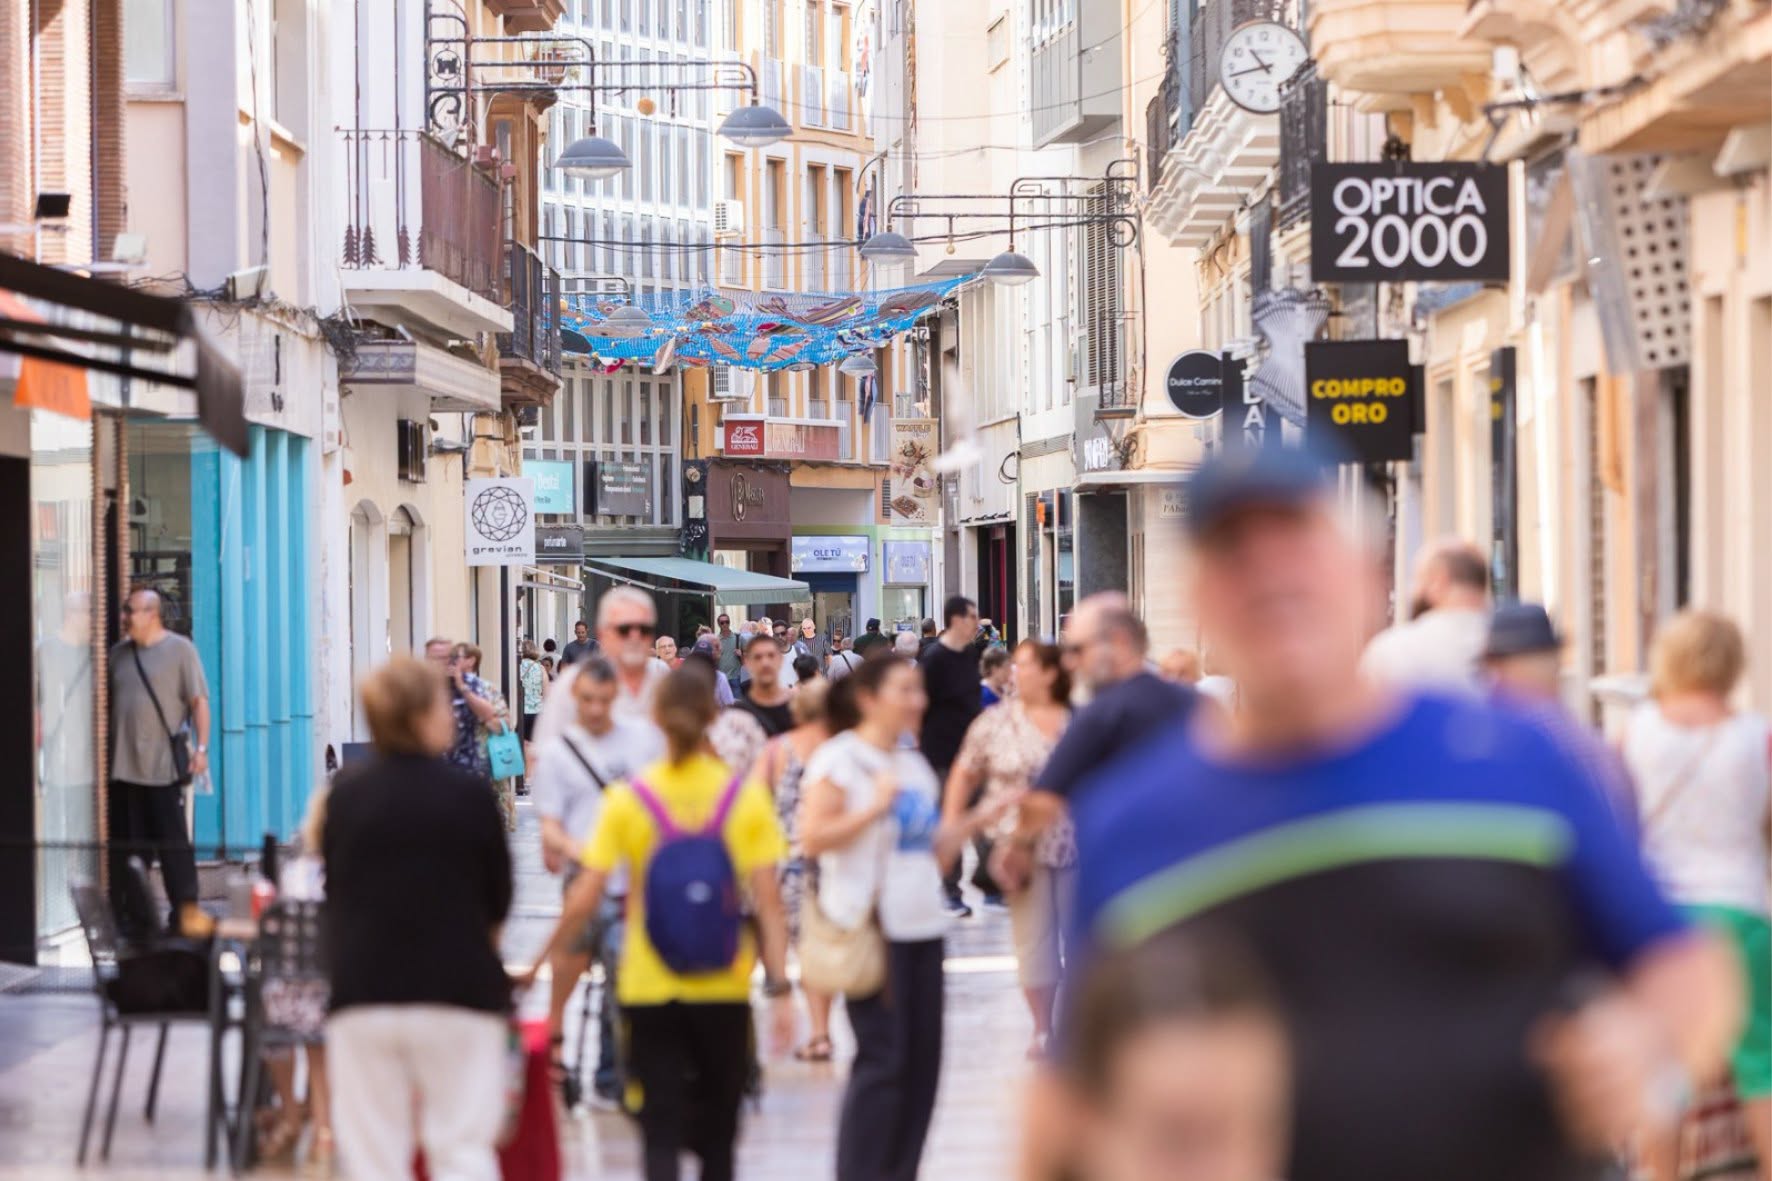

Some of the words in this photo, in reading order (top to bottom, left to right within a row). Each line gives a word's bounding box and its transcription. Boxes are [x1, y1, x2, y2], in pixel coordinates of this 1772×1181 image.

[1332, 176, 1486, 216] OPTICA
[1335, 214, 1488, 268] 2000
[1169, 377, 1192, 387] Dulce
[1312, 377, 1406, 399] COMPRO
[1331, 402, 1388, 424] ORO
[813, 549, 828, 557] OLE
